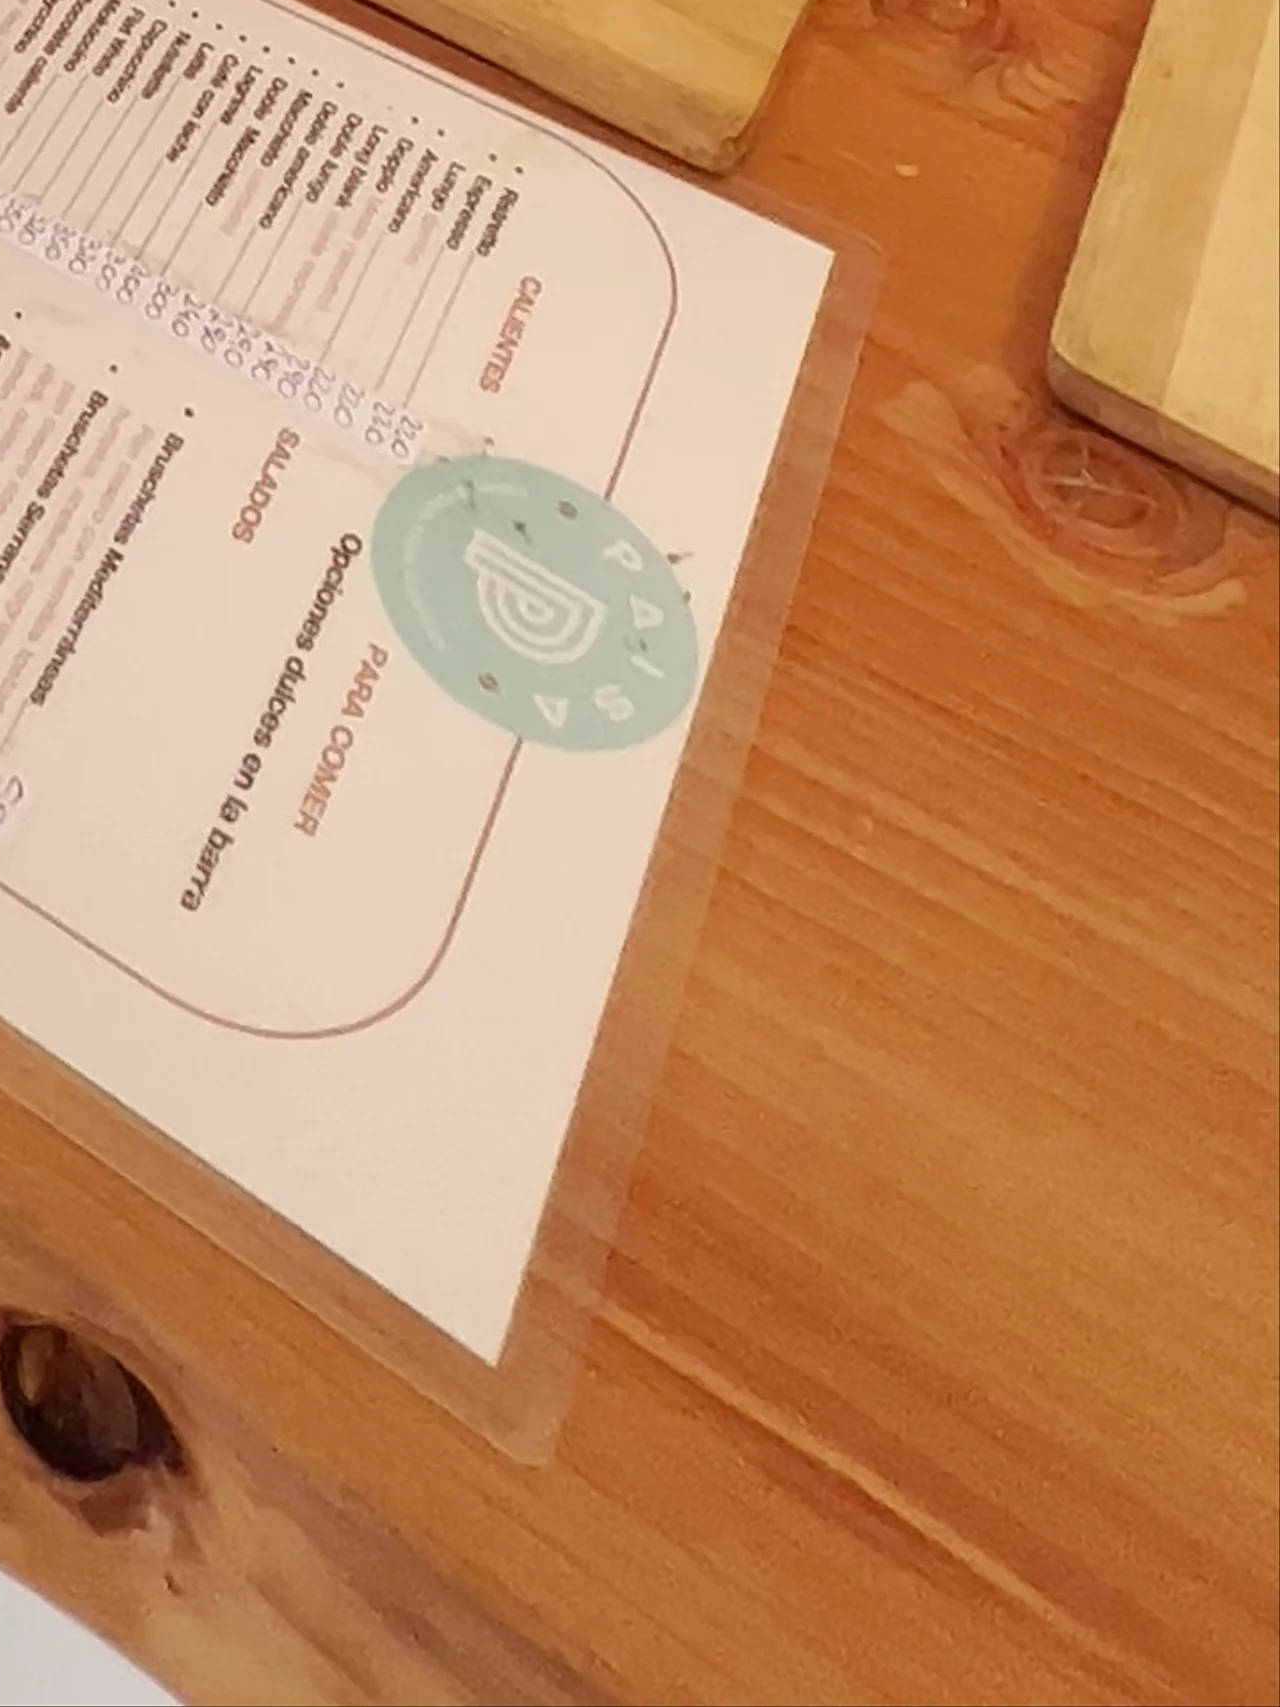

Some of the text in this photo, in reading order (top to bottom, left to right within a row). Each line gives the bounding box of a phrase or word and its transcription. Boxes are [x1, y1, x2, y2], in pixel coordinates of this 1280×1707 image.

[116, 5, 146, 37] Flat
[3, 54, 49, 116] caliente
[189, 87, 216, 121] con
[251, 75, 289, 122] Doble
[302, 99, 339, 146] Doble
[163, 117, 202, 164] leche
[203, 124, 262, 208] Macchiato
[258, 87, 314, 168] Macchiato
[327, 111, 364, 159] Doble
[352, 122, 390, 166] Long
[374, 135, 416, 194] Doppio
[256, 144, 311, 231] americano
[303, 157, 340, 205] lungo
[385, 146, 440, 234] Americano
[429, 160, 467, 213] Lungo
[443, 172, 493, 252] Espresso
[473, 185, 520, 258] Ristretto
[477, 275, 543, 394] CALIENTES
[34, 388, 110, 501] Bruschetas
[111, 431, 186, 546] Bruschetas
[230, 426, 301, 545] SALADOS
[27, 545, 125, 708] Mediterráneas
[530, 534, 667, 728] PAISA
[178, 531, 363, 913] Opciones dulces en la barra
[291, 641, 389, 838] PARA COMER
